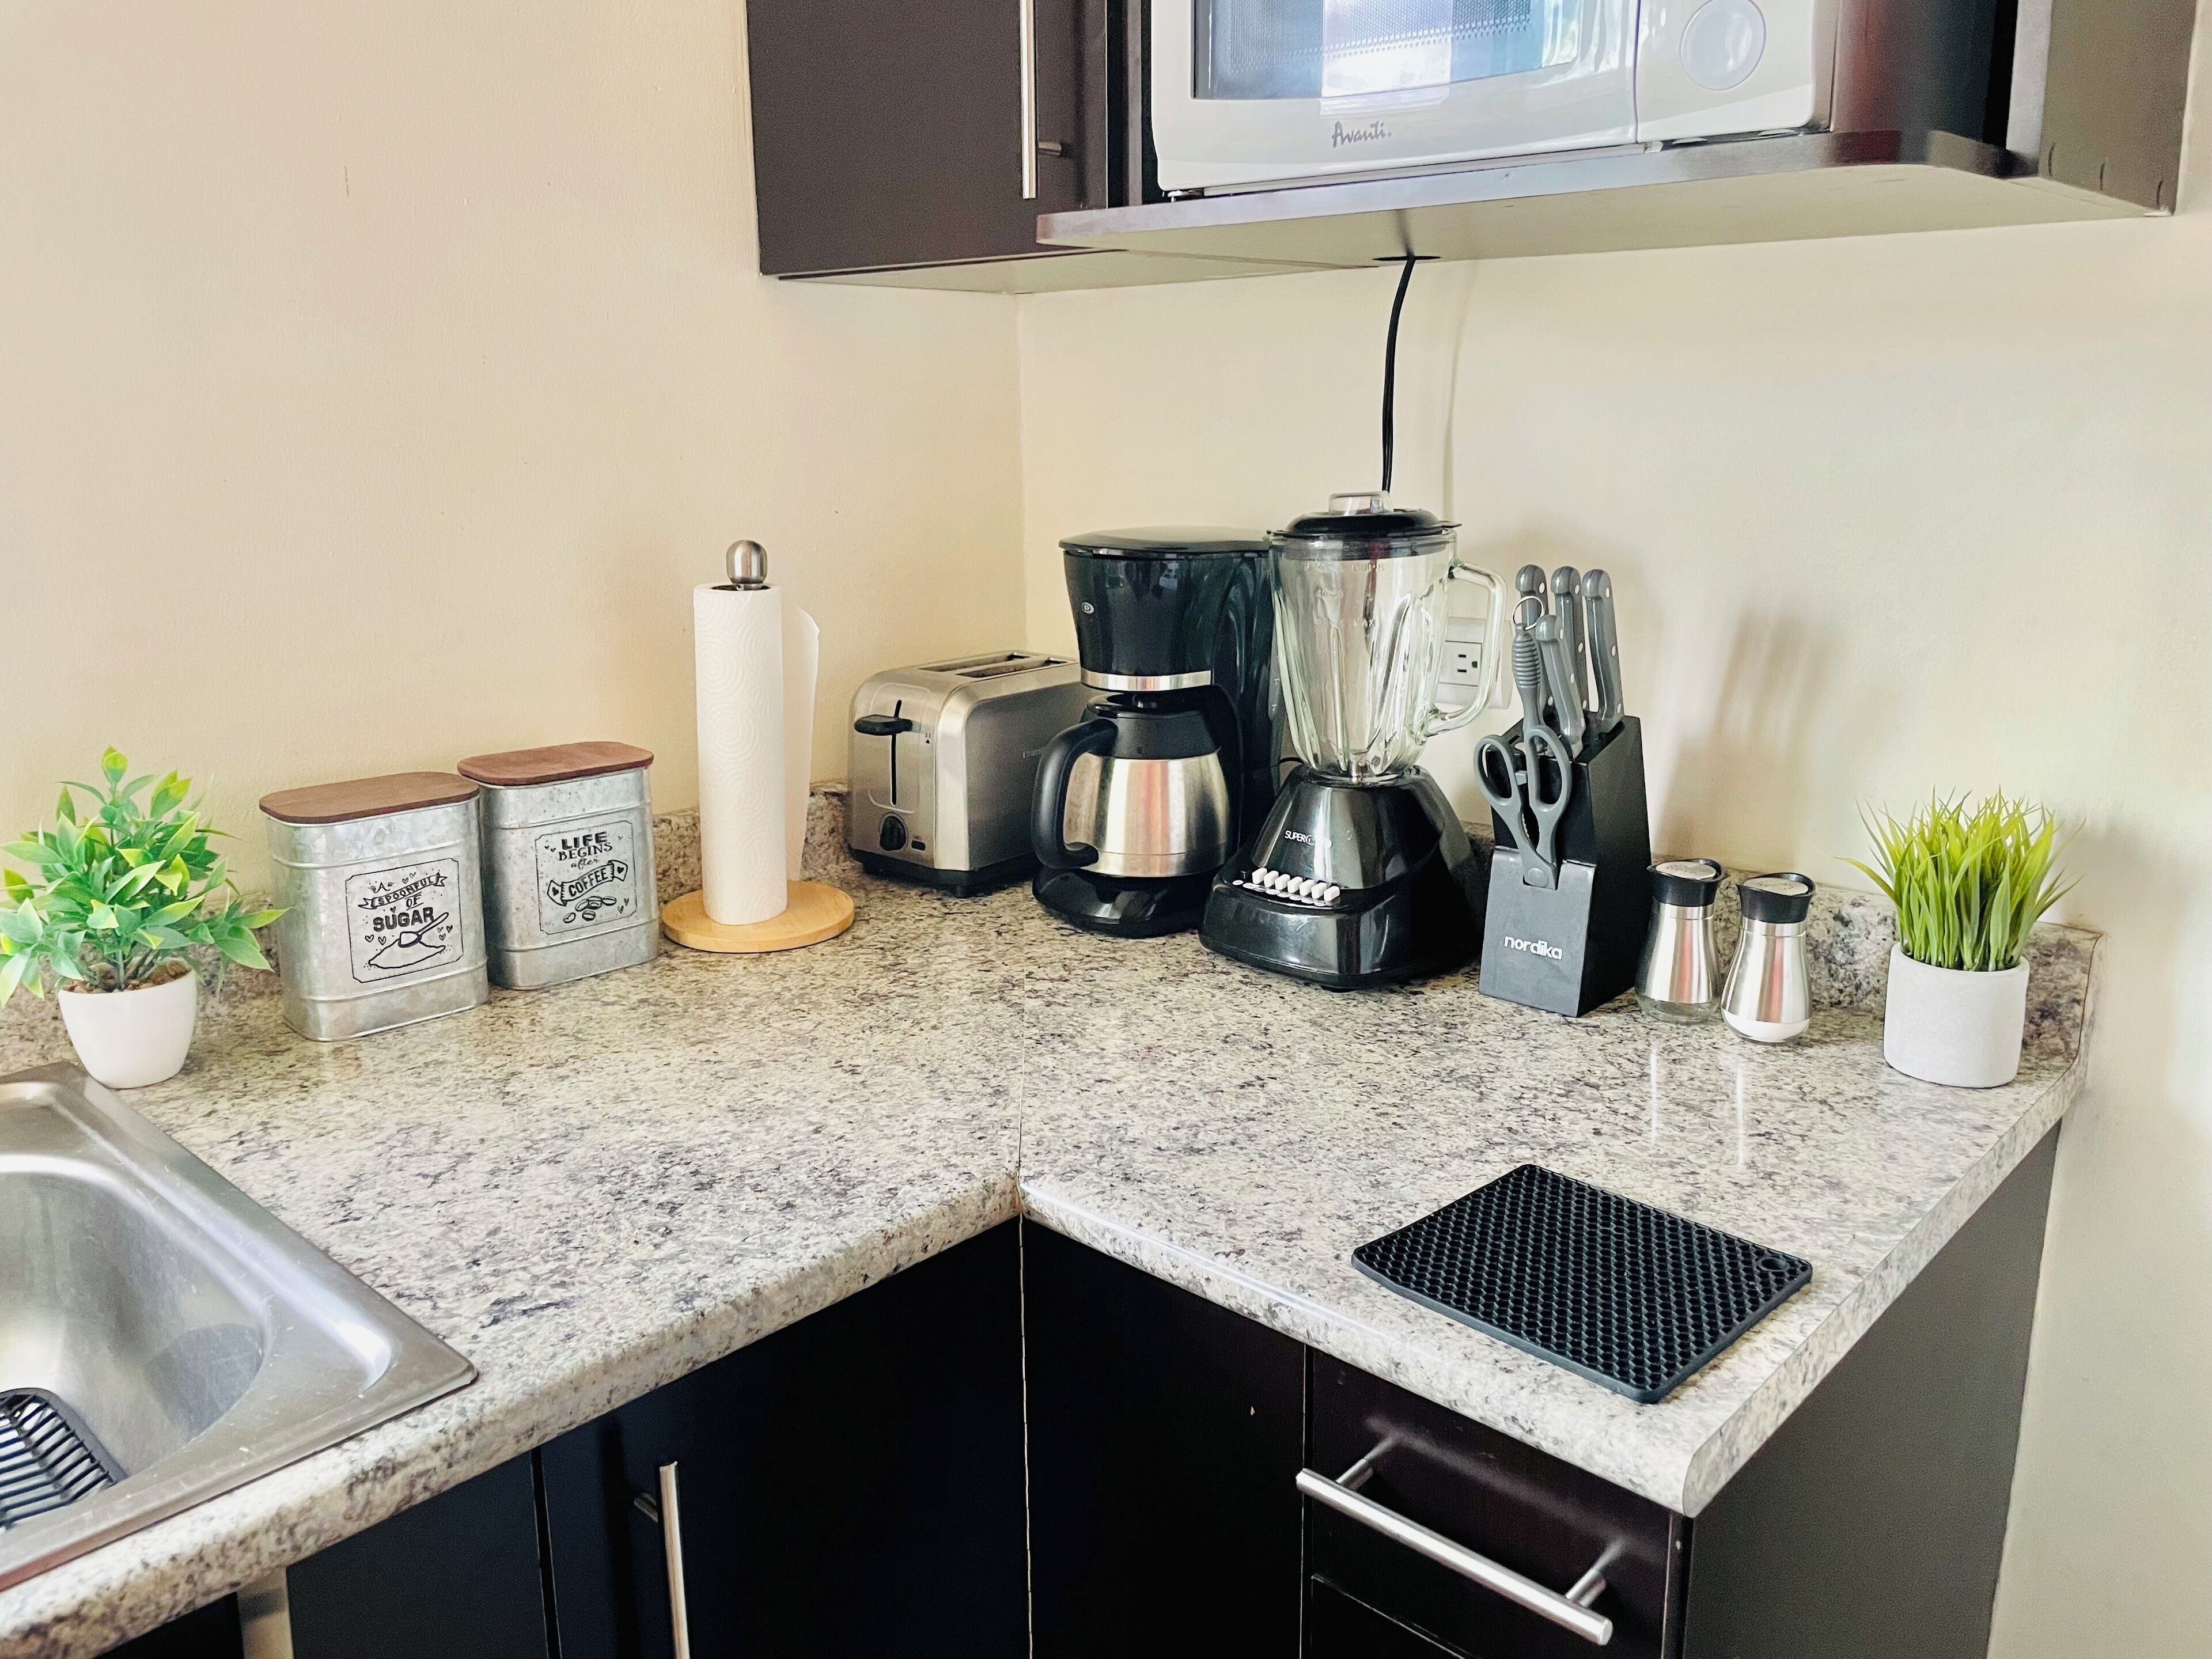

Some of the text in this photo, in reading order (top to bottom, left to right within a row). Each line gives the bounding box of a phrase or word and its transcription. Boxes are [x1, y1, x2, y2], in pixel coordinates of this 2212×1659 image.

[561, 831, 608, 850] LIFE
[558, 843, 613, 861] BEGINS
[571, 856, 600, 870] after
[378, 876, 434, 905] SPOONFUL
[568, 868, 608, 897] COFFEE
[406, 895, 421, 908] OF
[373, 907, 434, 932] SUGAR
[1504, 936, 1563, 960] nordika
